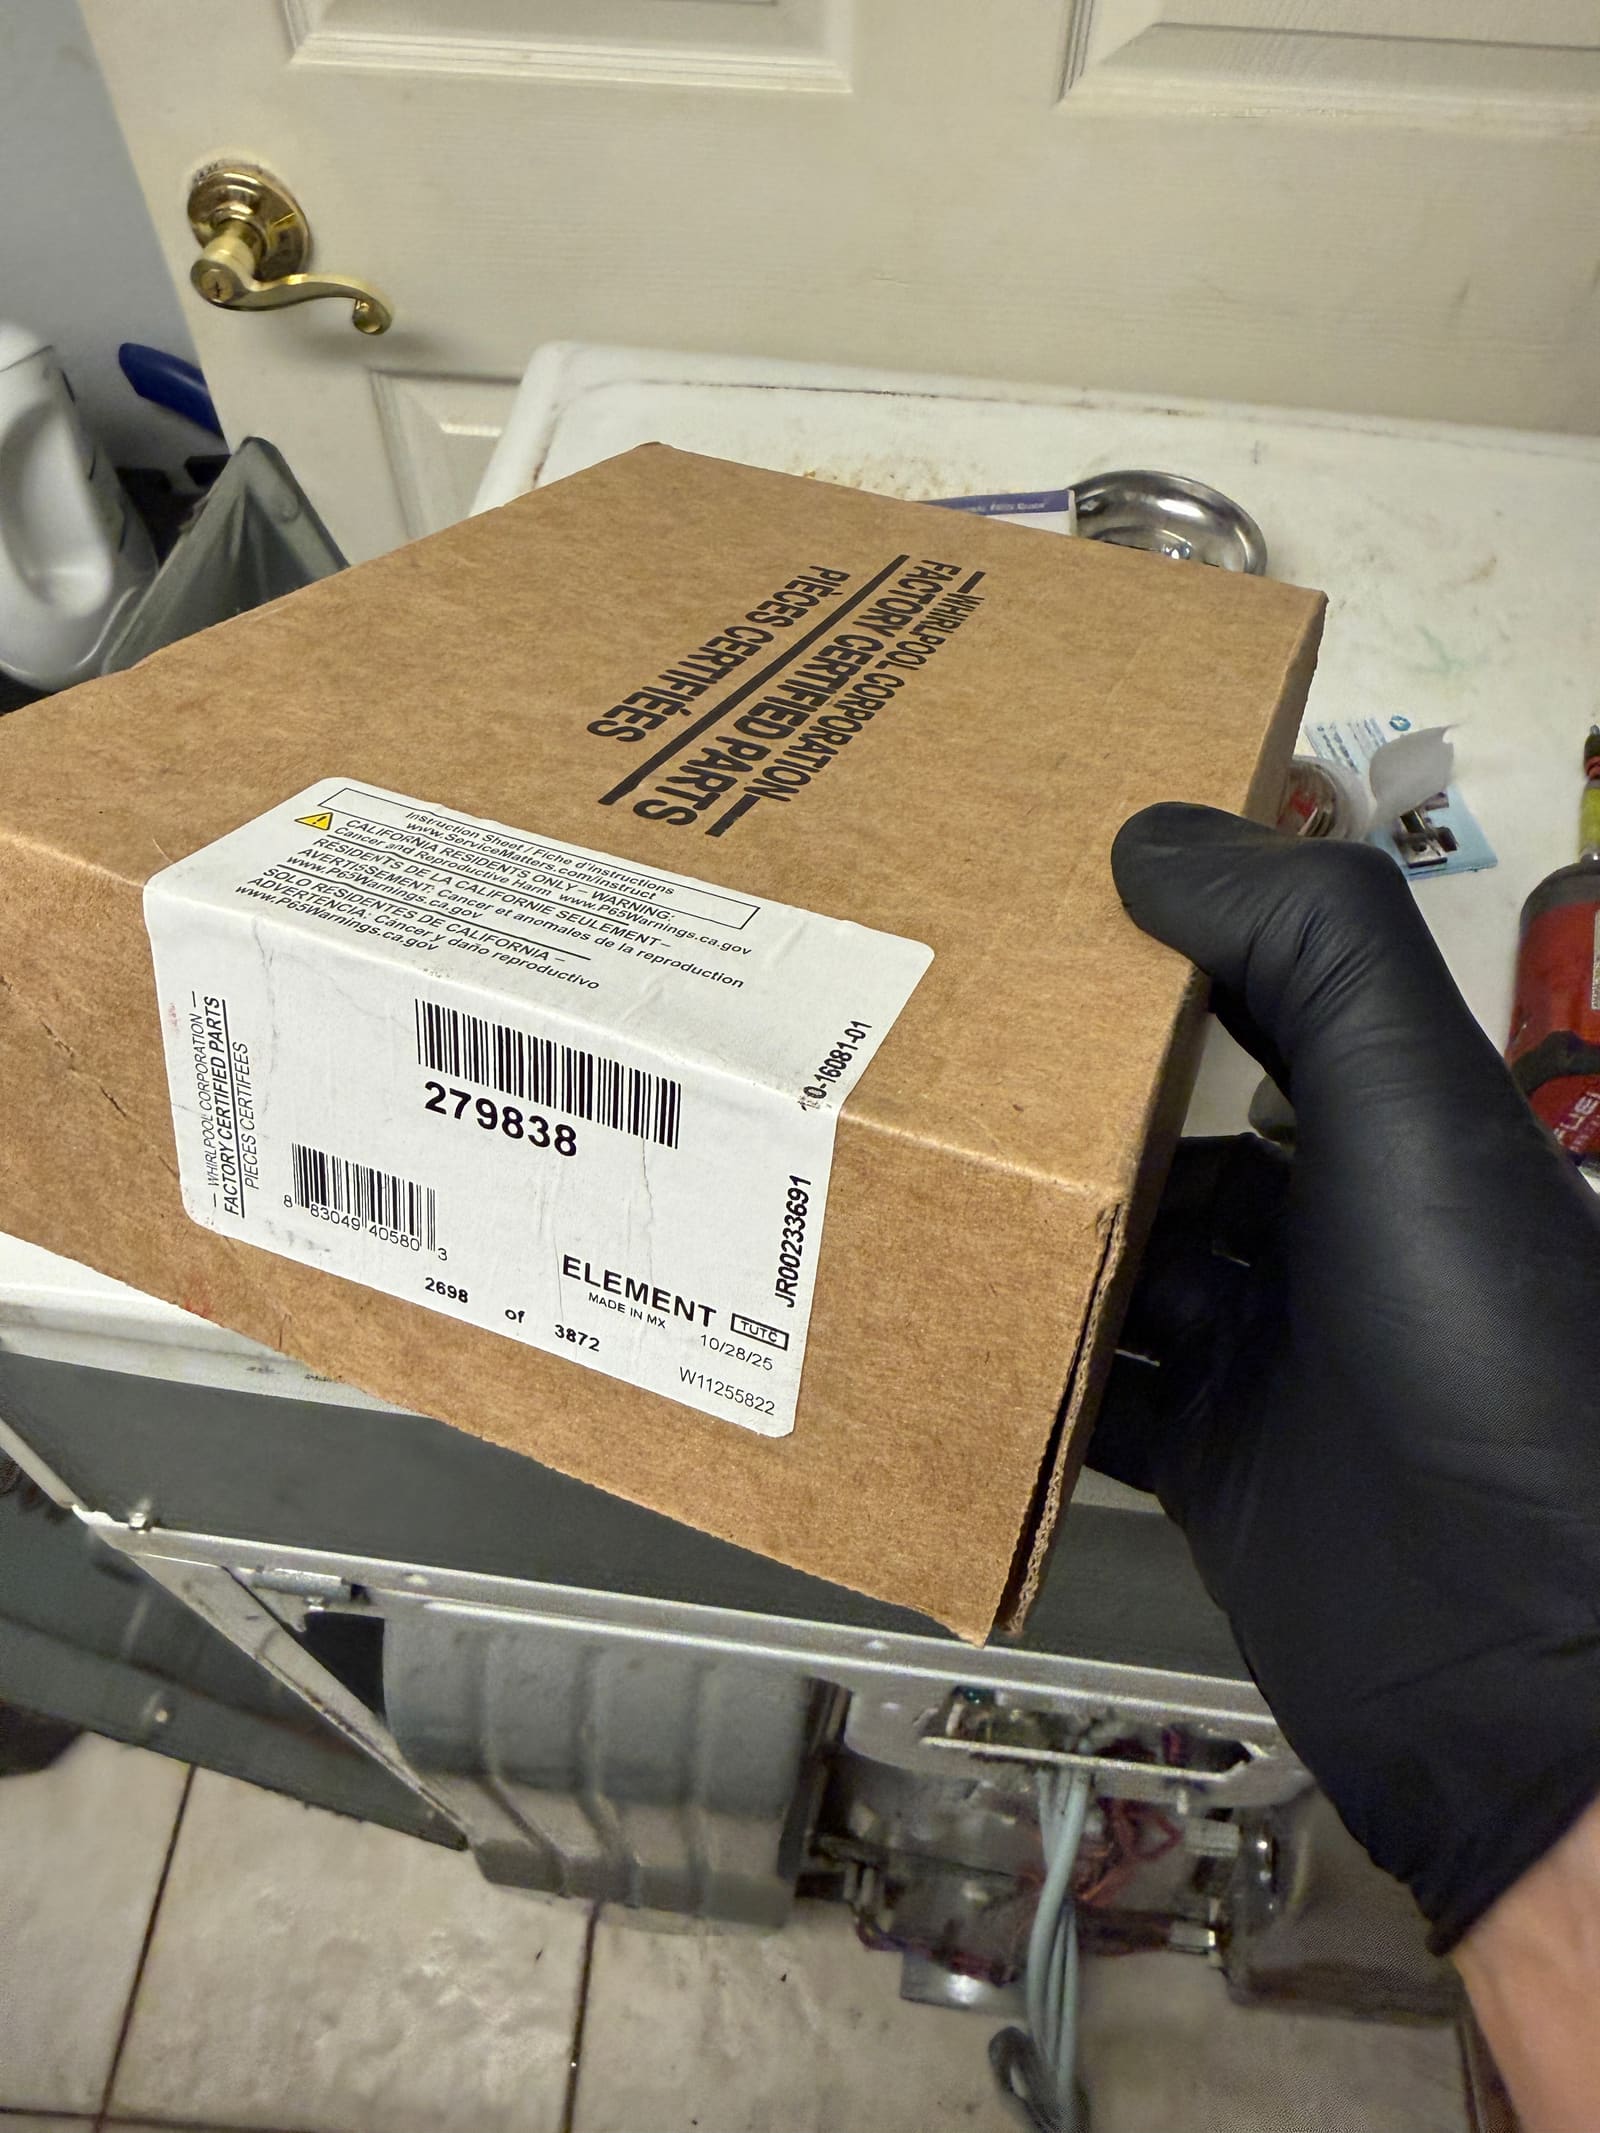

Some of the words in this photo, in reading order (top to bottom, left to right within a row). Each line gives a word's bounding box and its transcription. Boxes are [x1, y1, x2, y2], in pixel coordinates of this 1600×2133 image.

[745, 566, 850, 627] PIÈCES
[853, 560, 962, 637] FACTORY
[875, 593, 985, 670] WHIRLPOOL
[587, 626, 774, 742] CERTIFIÉES
[733, 634, 884, 739] CERTIFIED
[743, 673, 904, 801] CORPORATION
[633, 736, 771, 825] PARTS
[286, 856, 483, 919] www.P65Warnings.ca.gov
[334, 827, 386, 846] Cancer
[385, 843, 416, 854] and
[414, 850, 509, 884] Reproductive
[511, 879, 552, 896] Harm
[559, 893, 752, 955] www.P65Warnings.ca.gov
[346, 820, 438, 852] CALIFORNIA
[440, 847, 531, 878] RESIDENTS
[532, 874, 577, 891] ONLY
[591, 890, 675, 922] WARNING:
[404, 865, 431, 878] DE
[429, 872, 453, 885] LA
[454, 880, 555, 915] CALIFORNIE
[405, 812, 480, 838] Instruction
[482, 834, 524, 850] Sheet
[532, 849, 573, 865] Fiche
[575, 861, 675, 895] d'instructions
[406, 822, 656, 901] www.ServiceMatters.com/instruct
[235, 885, 440, 951] www.P65Warnings.ca.gov
[248, 877, 372, 919] ADVERTENCIA:
[429, 933, 447, 942] y
[448, 937, 490, 956] daño
[491, 951, 600, 989] reproductivo
[263, 868, 312, 886] SOLO
[311, 882, 418, 919] RESIDENTES
[417, 914, 446, 928] DE
[446, 923, 550, 961] CALIFORNIA
[297, 848, 435, 892] AVERTISSEMENT:
[437, 888, 494, 911] Cancer
[495, 907, 513, 917] et
[513, 912, 591, 941] anomales
[594, 936, 616, 948] de
[617, 942, 634, 954] la
[635, 949, 745, 988] reproduction
[189, 1013, 212, 1111] CORPORATION
[204, 996, 225, 1053] PARTS
[211, 1056, 233, 1140] CERTIFIED
[424, 1080, 577, 1157] 279838
[201, 1114, 219, 1187] WHIRLPOOL
[218, 1141, 239, 1216] FACTORY
[241, 1133, 260, 1190] PIECES
[283, 1194, 293, 1208] 8
[310, 1203, 360, 1231] 83049
[369, 1225, 421, 1251] 40580
[437, 1247, 448, 1261] 3
[775, 1174, 811, 1308] JR00233691
[425, 1277, 468, 1304] 2698
[504, 1309, 525, 1324] of
[554, 1324, 600, 1352] 3872
[562, 1254, 717, 1328] ELEMENT
[588, 1292, 626, 1314] MADE
[630, 1307, 643, 1320] IN
[647, 1314, 666, 1329] MX
[700, 1334, 773, 1371] 10/28/25
[740, 1320, 777, 1343] TUTC
[679, 1366, 775, 1416] W11255822
